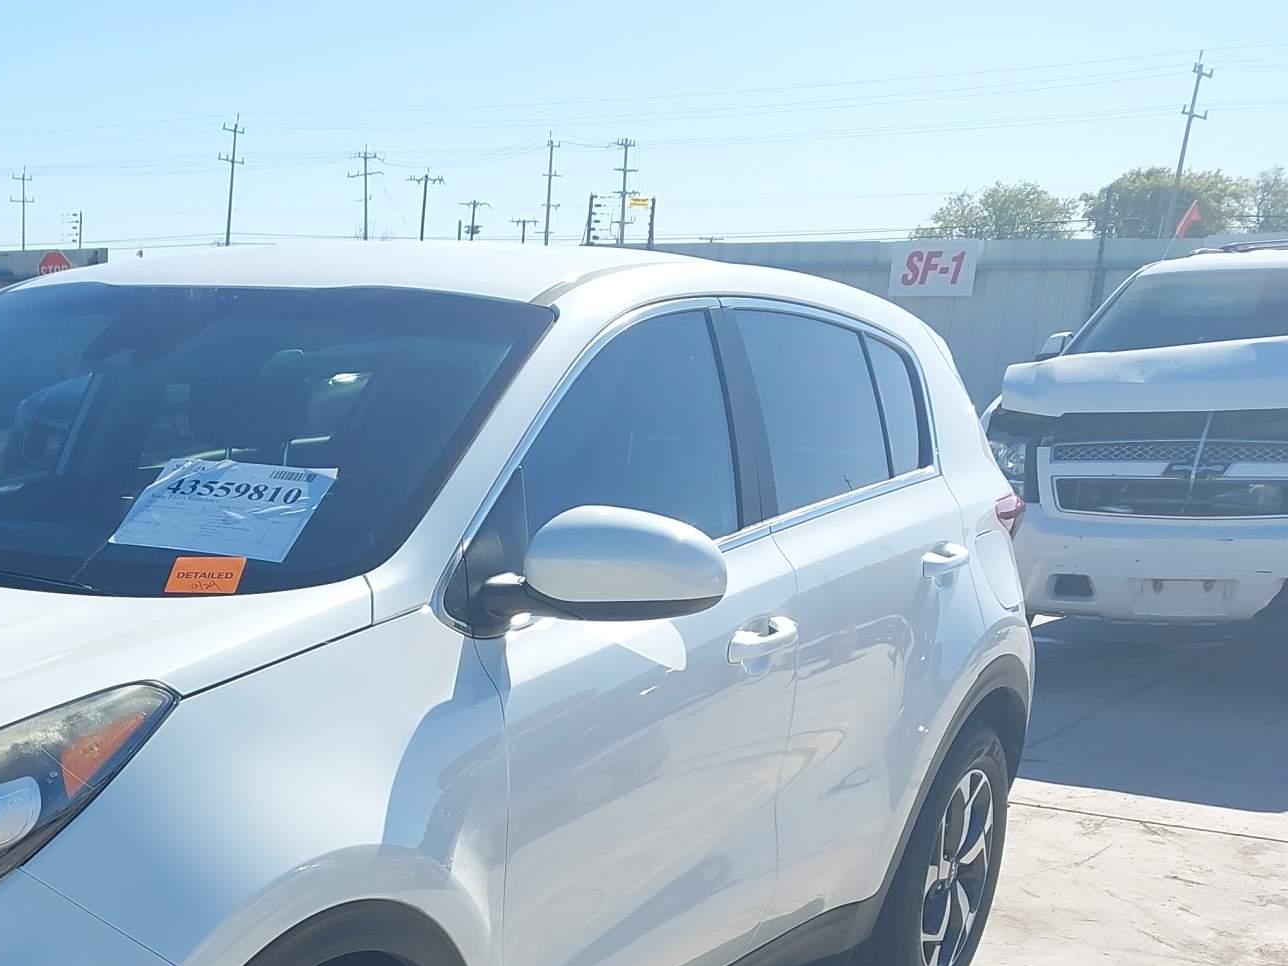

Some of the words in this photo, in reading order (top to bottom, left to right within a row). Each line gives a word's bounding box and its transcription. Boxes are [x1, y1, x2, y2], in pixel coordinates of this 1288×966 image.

[901, 250, 966, 286] SF-1
[166, 477, 303, 505] 43559810
[176, 571, 234, 579] DETAILED
